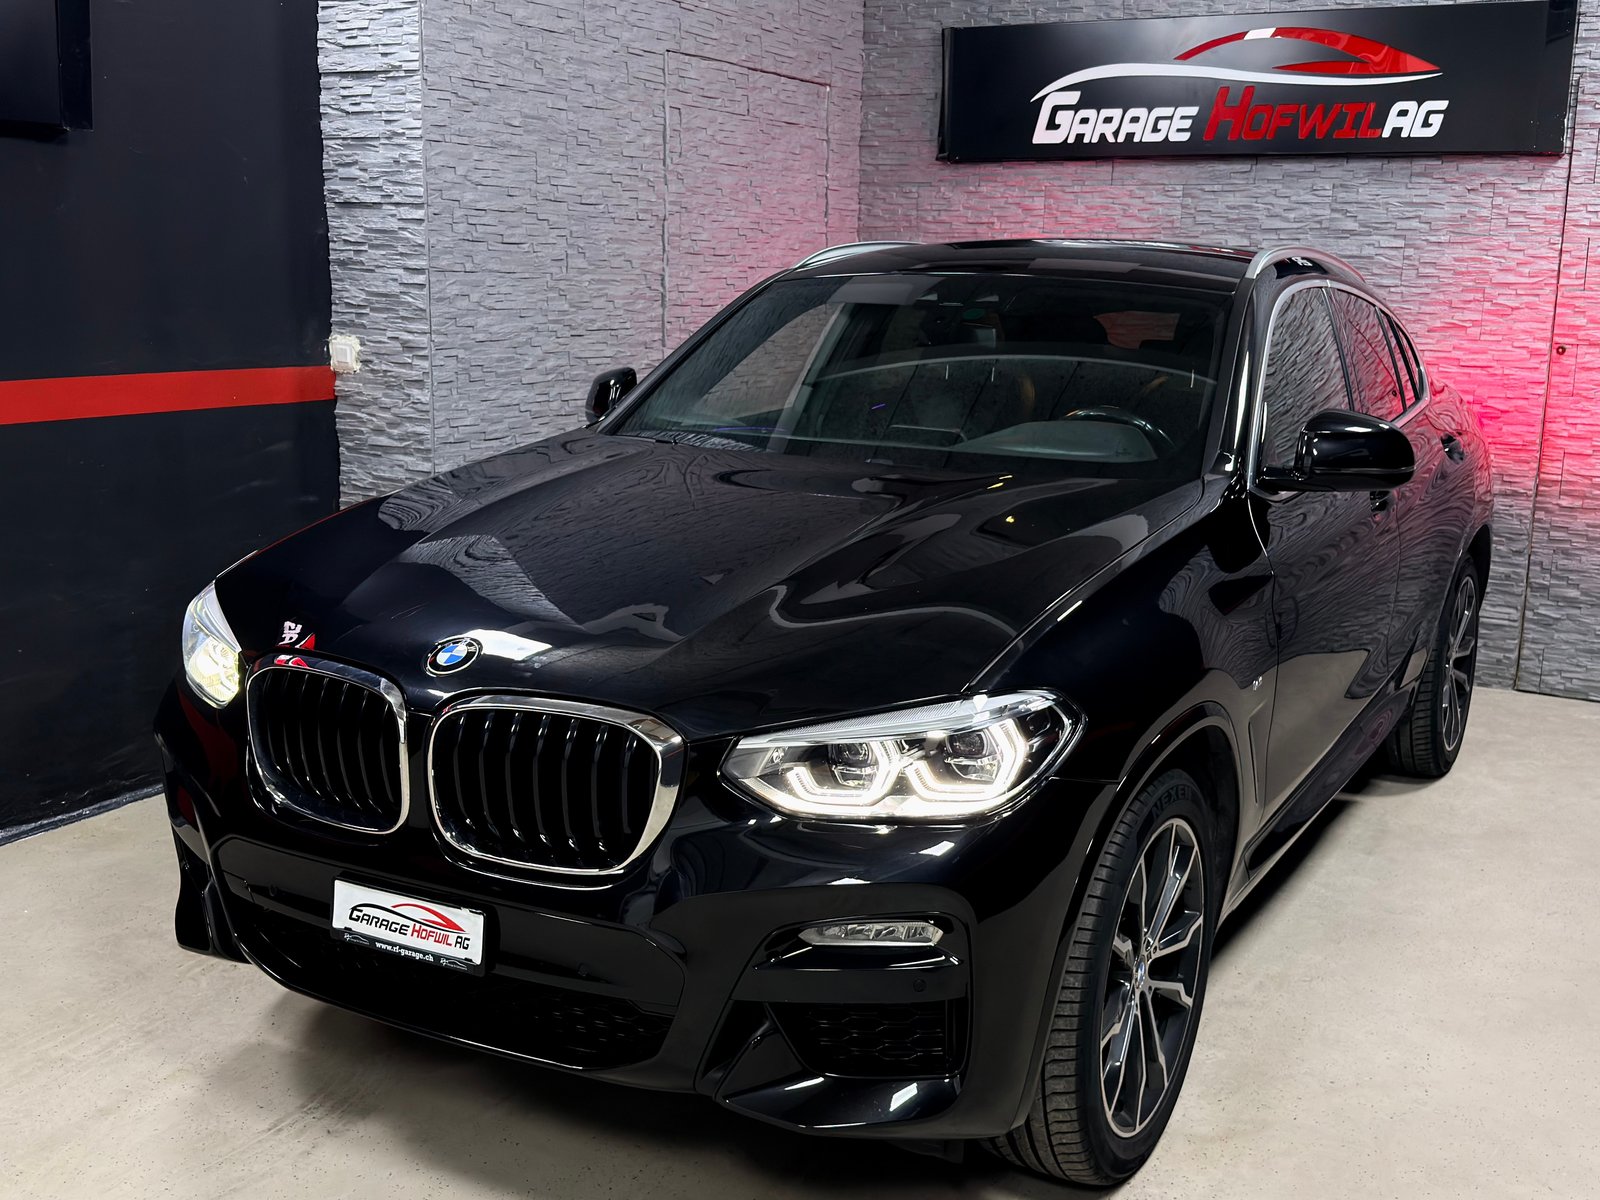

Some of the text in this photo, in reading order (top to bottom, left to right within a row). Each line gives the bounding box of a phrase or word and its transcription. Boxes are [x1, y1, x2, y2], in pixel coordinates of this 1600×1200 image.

[1032, 91, 1199, 144] GARAGE
[349, 909, 471, 950] GARAGE HOFWIL AG
[375, 941, 434, 962] www.rf-garage.ch
